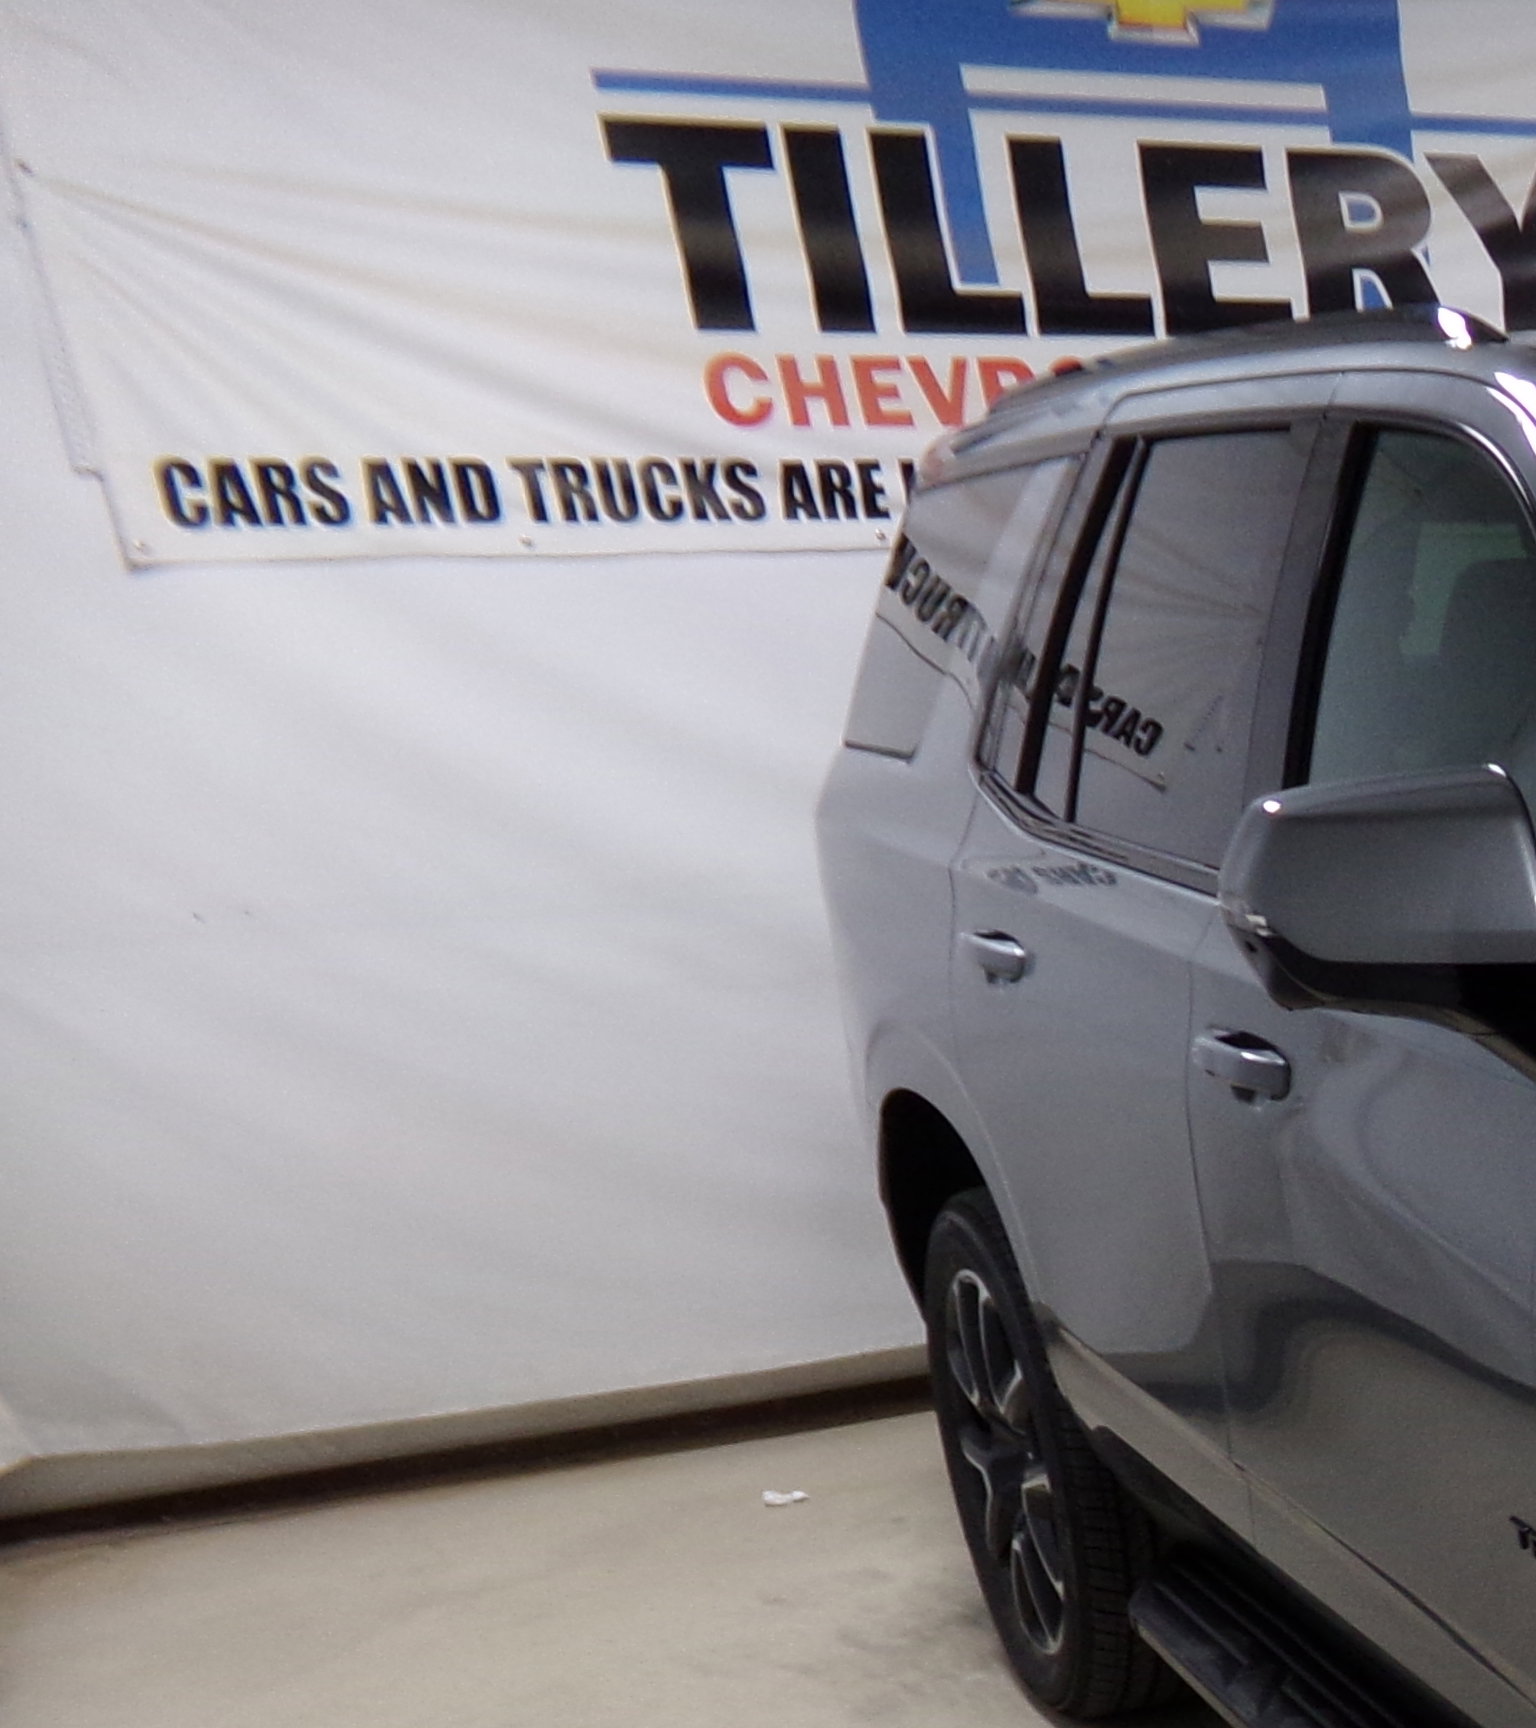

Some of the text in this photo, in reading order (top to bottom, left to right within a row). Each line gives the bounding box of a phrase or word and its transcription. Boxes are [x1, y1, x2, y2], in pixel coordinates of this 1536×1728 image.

[155, 456, 349, 528] CARS
[365, 458, 500, 526] AND
[509, 458, 765, 523] TRUCKS
[781, 458, 892, 521] ARE
